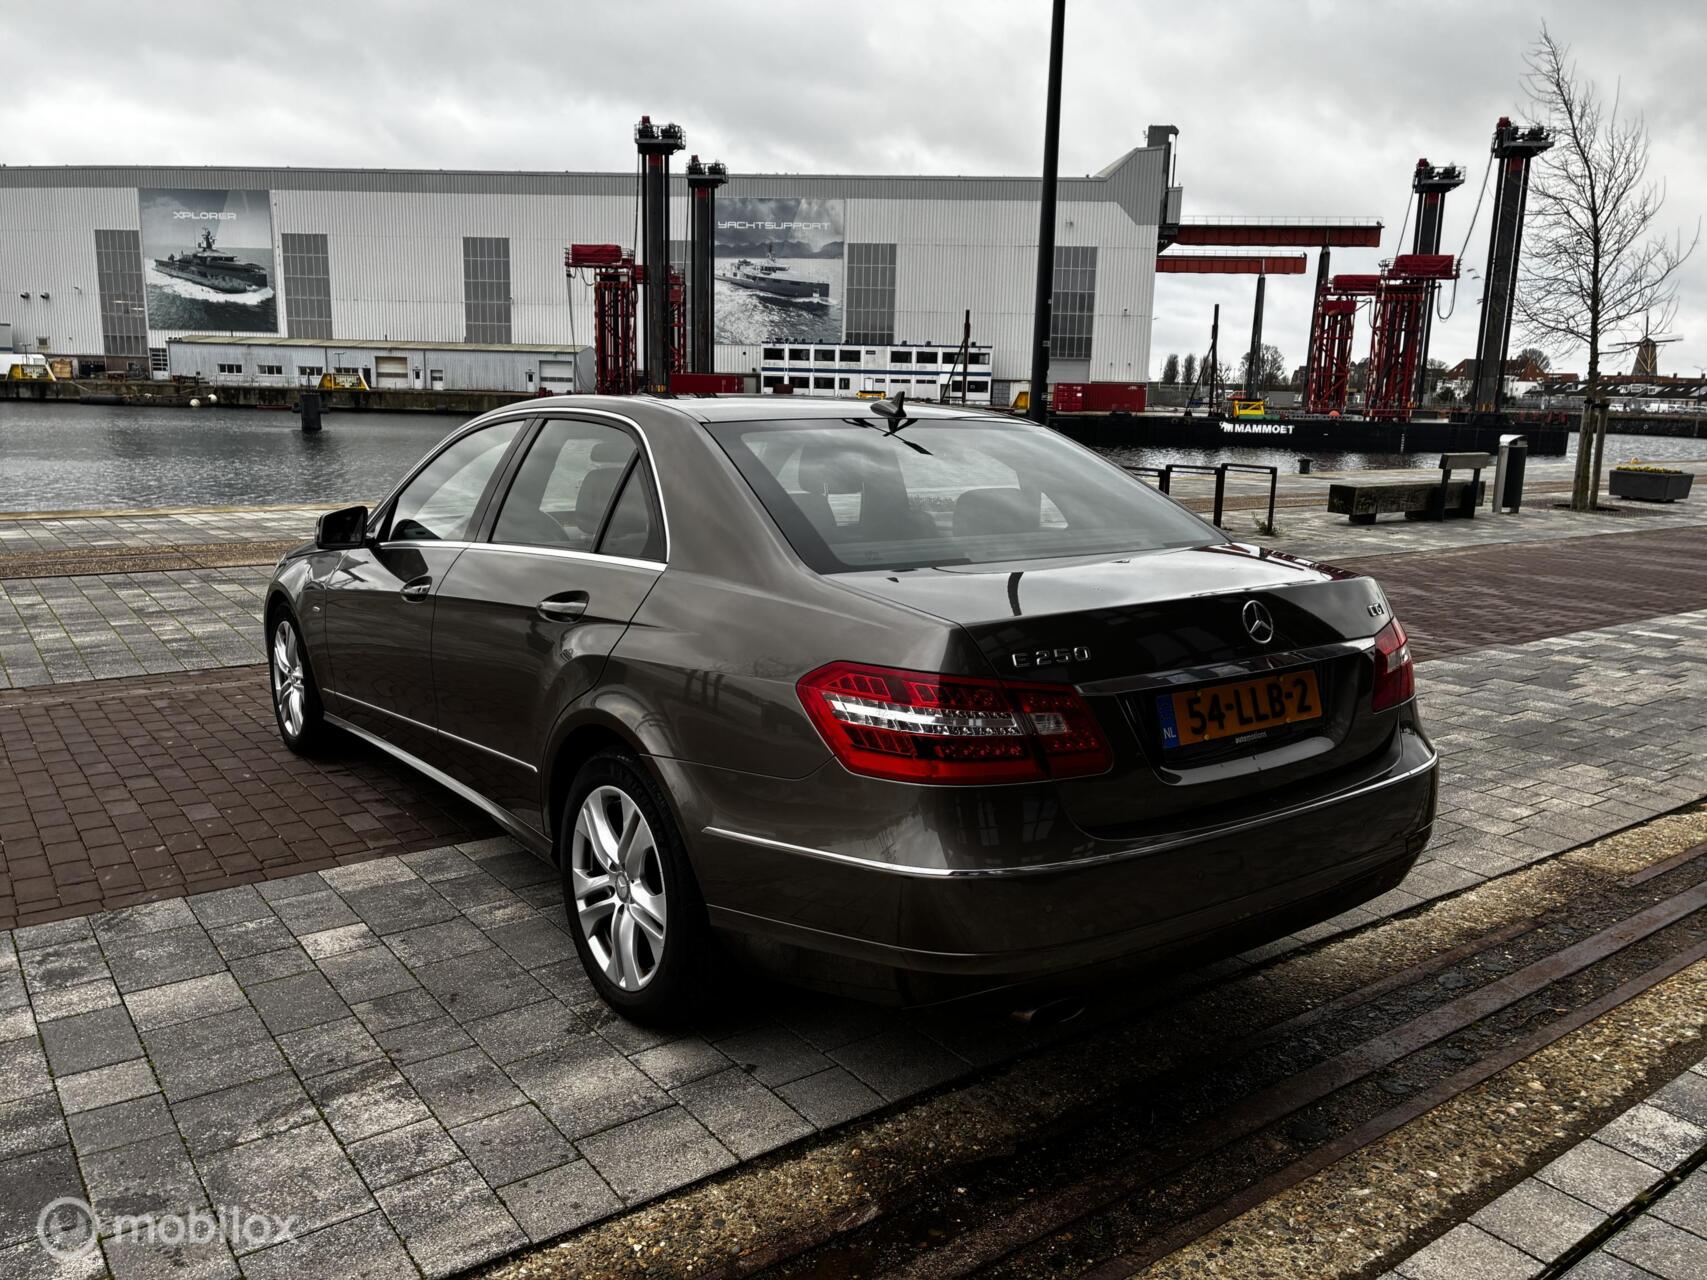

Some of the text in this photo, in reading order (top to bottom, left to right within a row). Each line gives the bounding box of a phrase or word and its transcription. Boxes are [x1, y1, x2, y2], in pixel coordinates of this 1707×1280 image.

[173, 211, 236, 220] XPLORER
[717, 221, 831, 231] YACHTSUPPORT
[1234, 423, 1295, 434] MAMMOET
[1012, 646, 1091, 668] E 250
[1187, 678, 1312, 735] 54-LLB-2
[1163, 727, 1177, 740] NL
